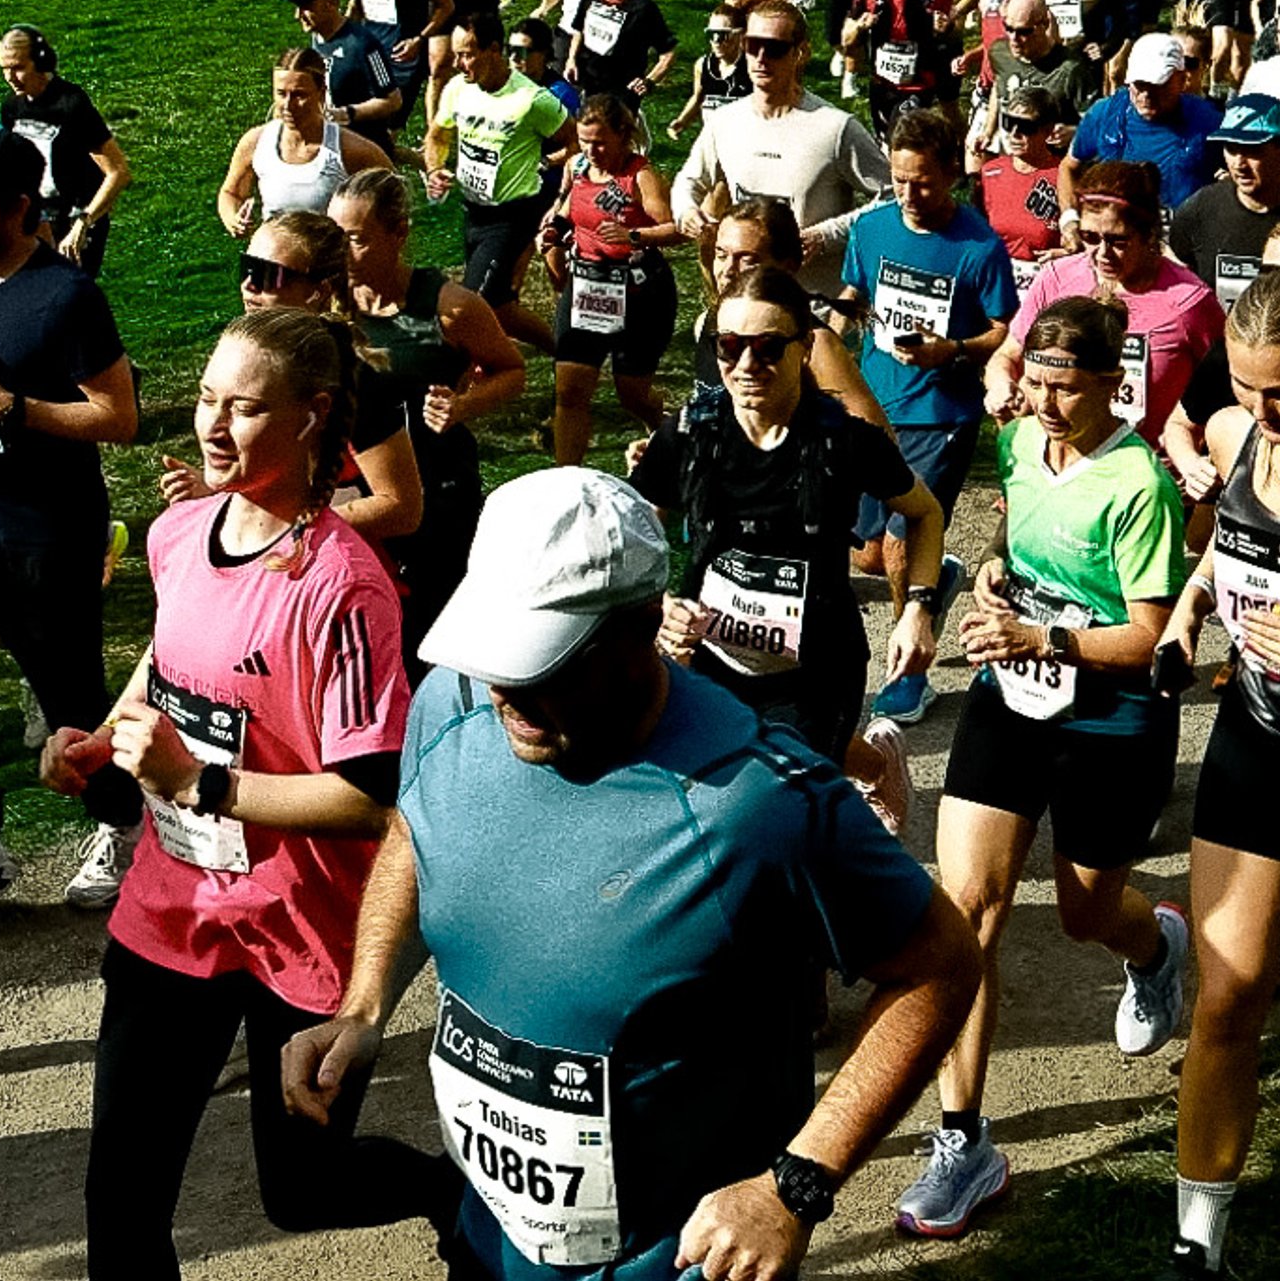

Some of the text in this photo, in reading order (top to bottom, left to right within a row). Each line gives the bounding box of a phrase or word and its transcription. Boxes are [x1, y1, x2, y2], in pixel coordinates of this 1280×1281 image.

[706, 606, 787, 655] 70880
[442, 1014, 500, 1062] tcs TATA
[549, 1083, 594, 1103] TATA
[478, 1098, 548, 1146] Tobias
[453, 1115, 586, 1208] 70867
